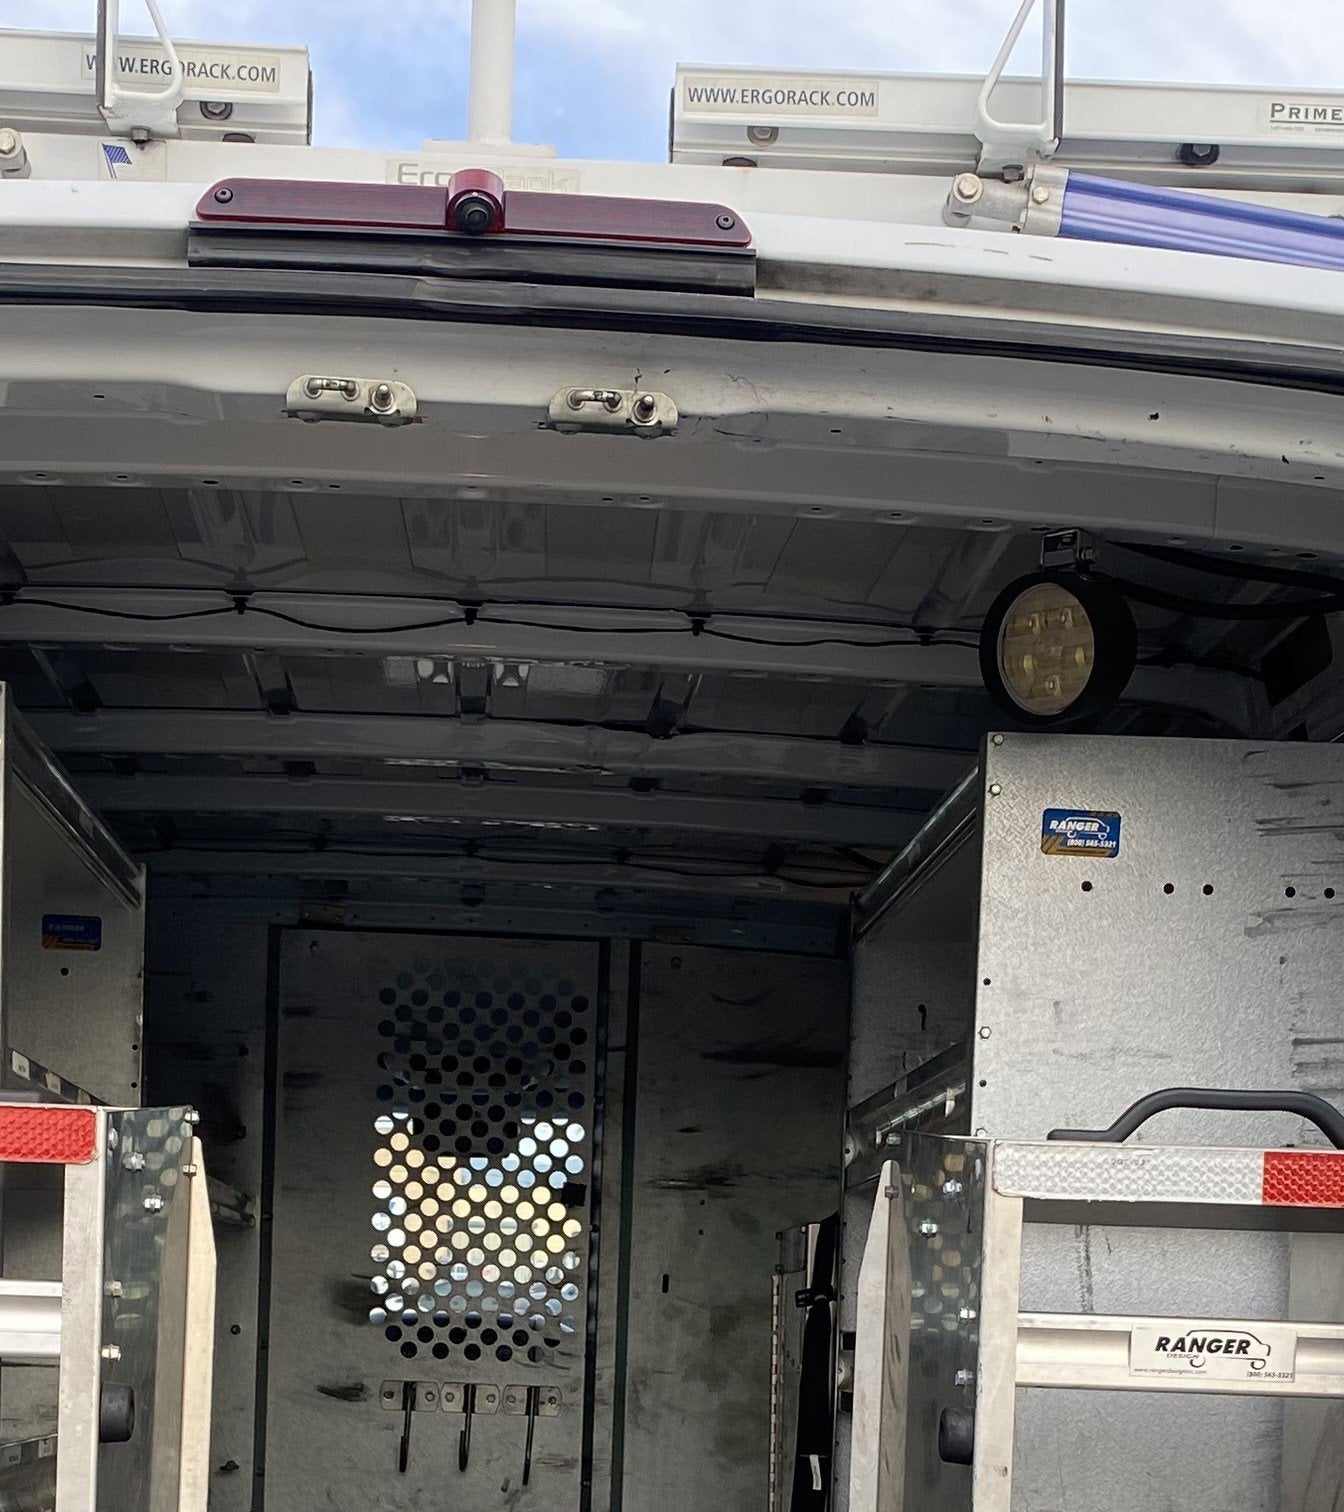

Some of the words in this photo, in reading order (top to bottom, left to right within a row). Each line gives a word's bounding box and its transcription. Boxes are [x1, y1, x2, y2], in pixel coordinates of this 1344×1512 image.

[86, 54, 276, 83] WW.ERGRACK.COM
[688, 86, 875, 107] WWW.ERGORACK.COM
[1270, 102, 1343, 121] PRIME
[1049, 820, 1100, 831] RANGER
[1154, 1336, 1252, 1355] RANGER
